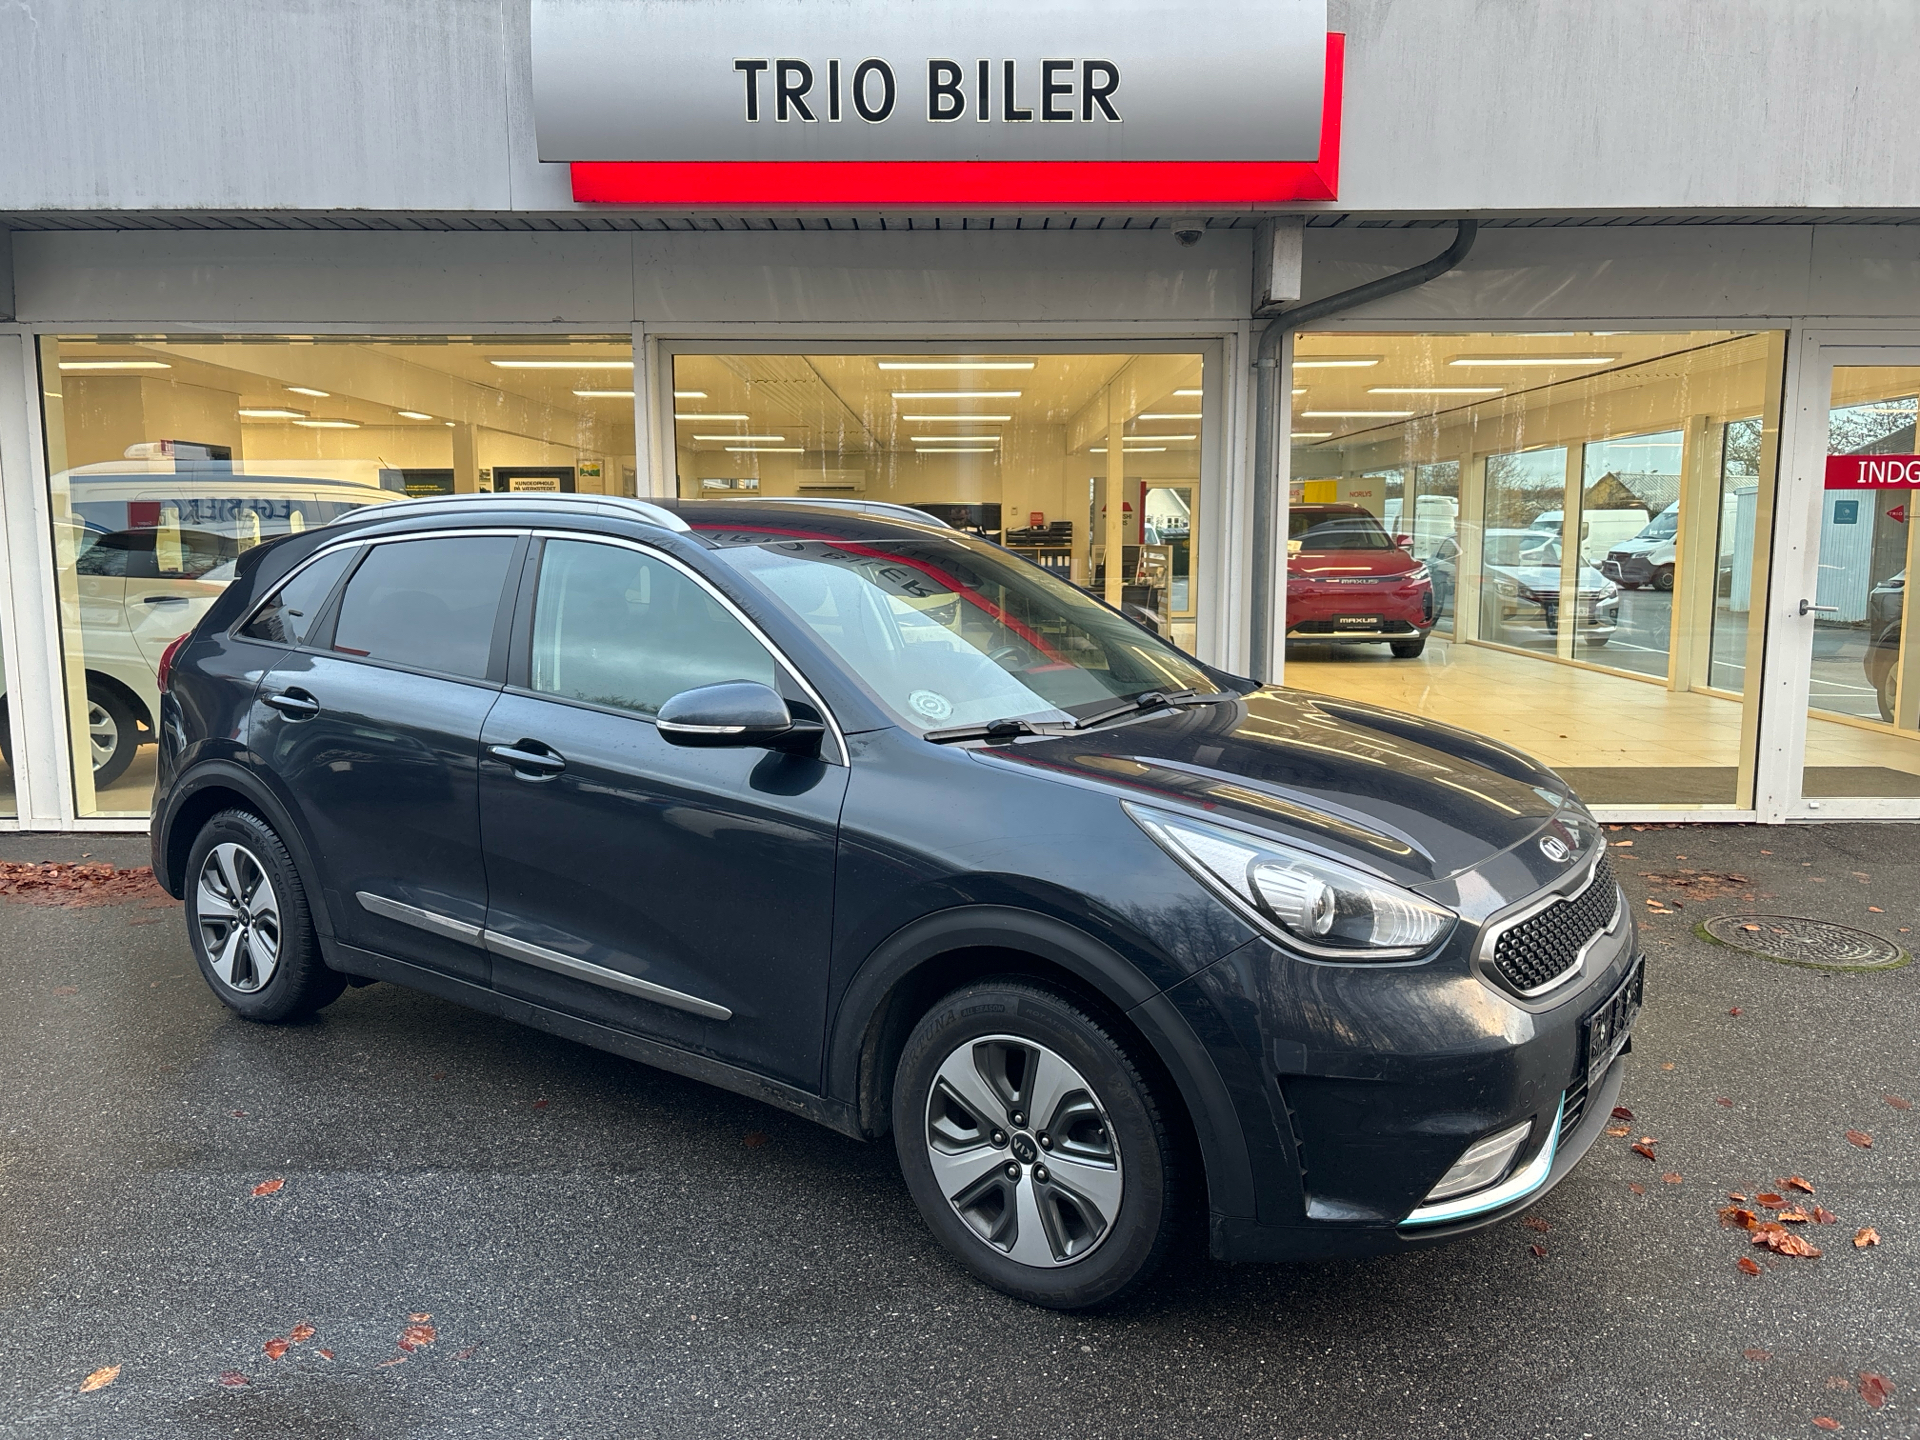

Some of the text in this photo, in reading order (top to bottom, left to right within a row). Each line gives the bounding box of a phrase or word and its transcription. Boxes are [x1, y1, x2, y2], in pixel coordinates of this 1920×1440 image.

[733, 56, 1124, 124] TRIO BILER
[962, 1006, 975, 1017] ALL
[975, 1004, 1004, 1013] SEASON
[1026, 1008, 1073, 1036] ROTATION
[1013, 1137, 1034, 1160] KIA
